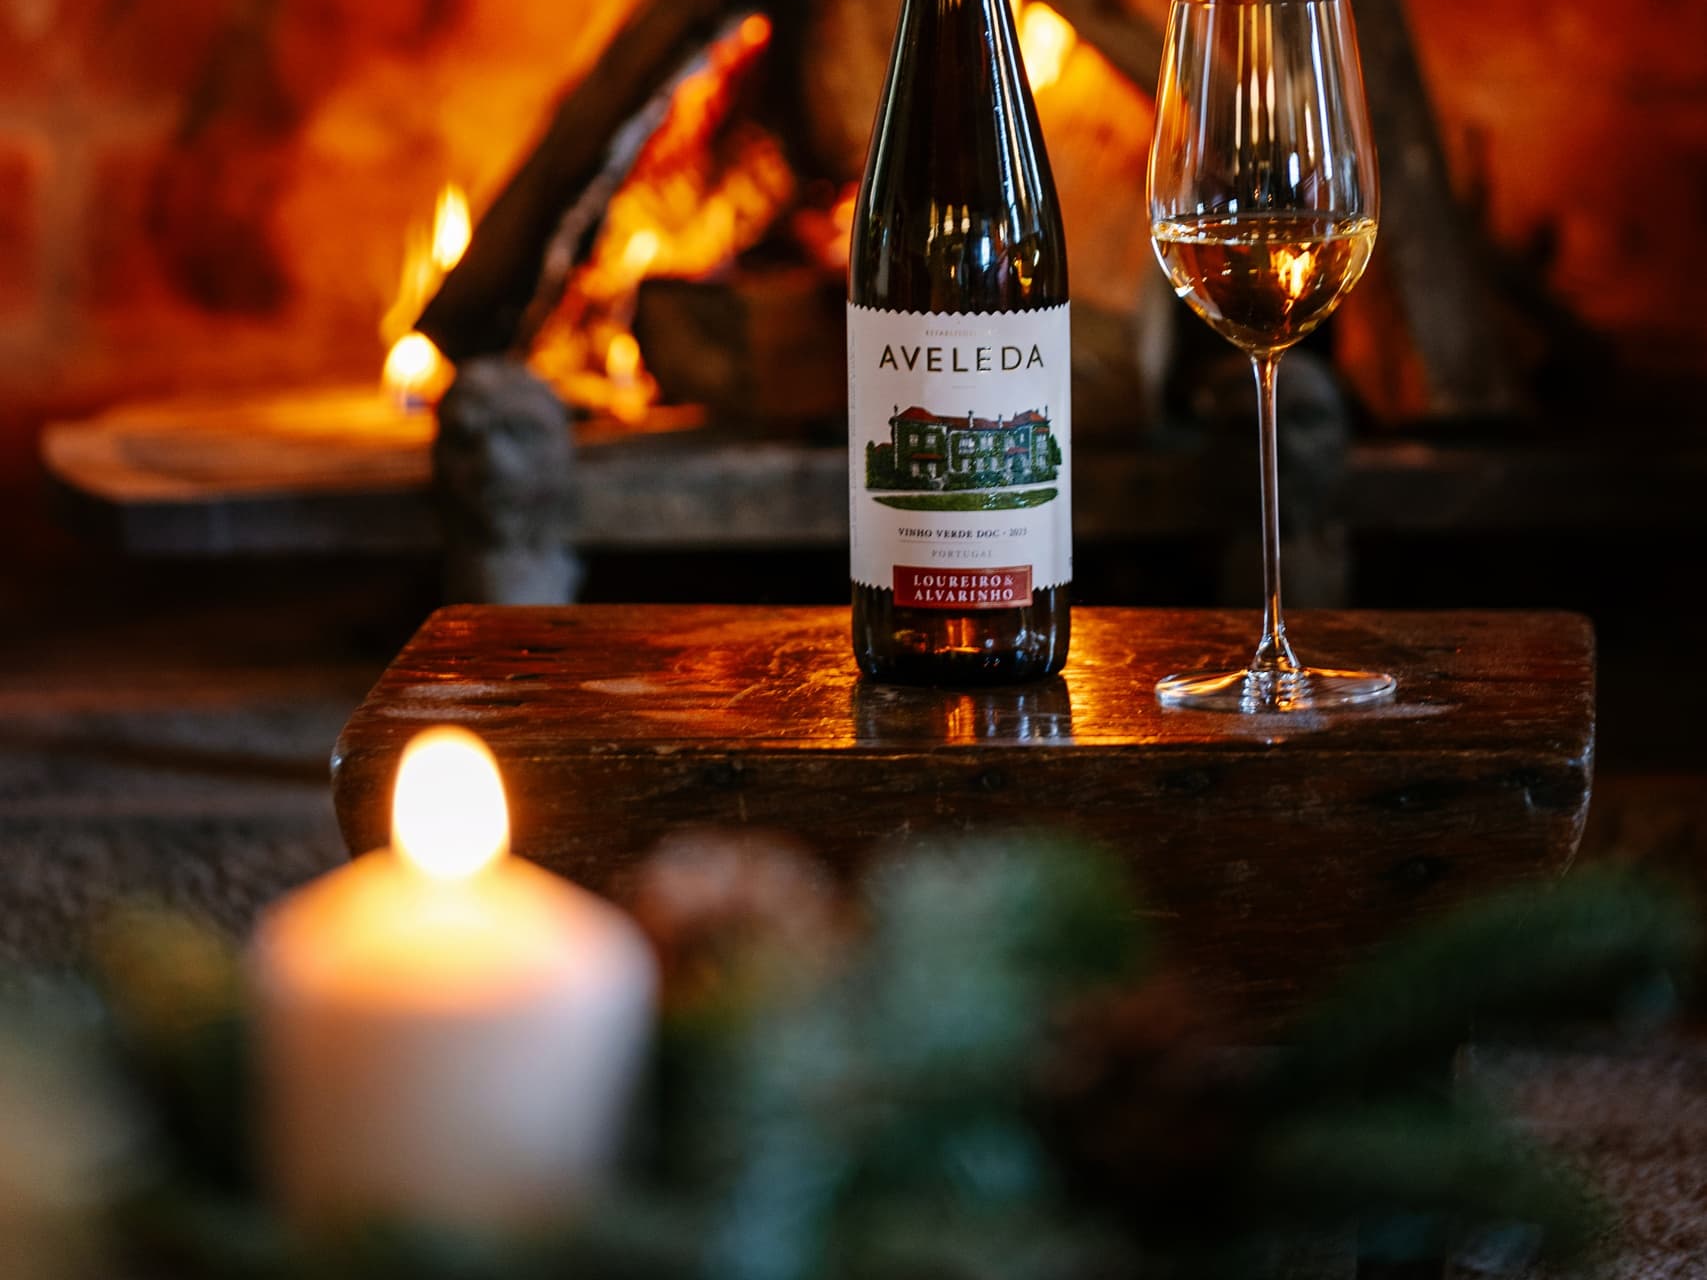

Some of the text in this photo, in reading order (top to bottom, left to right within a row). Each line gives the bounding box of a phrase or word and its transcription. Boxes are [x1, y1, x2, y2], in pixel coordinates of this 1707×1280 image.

[879, 344, 1044, 373] AVELEDA
[898, 527, 933, 538] VINHO
[936, 528, 973, 538] VERDE
[976, 528, 1000, 538] DOC
[914, 589, 1014, 602] ALVARINHO
